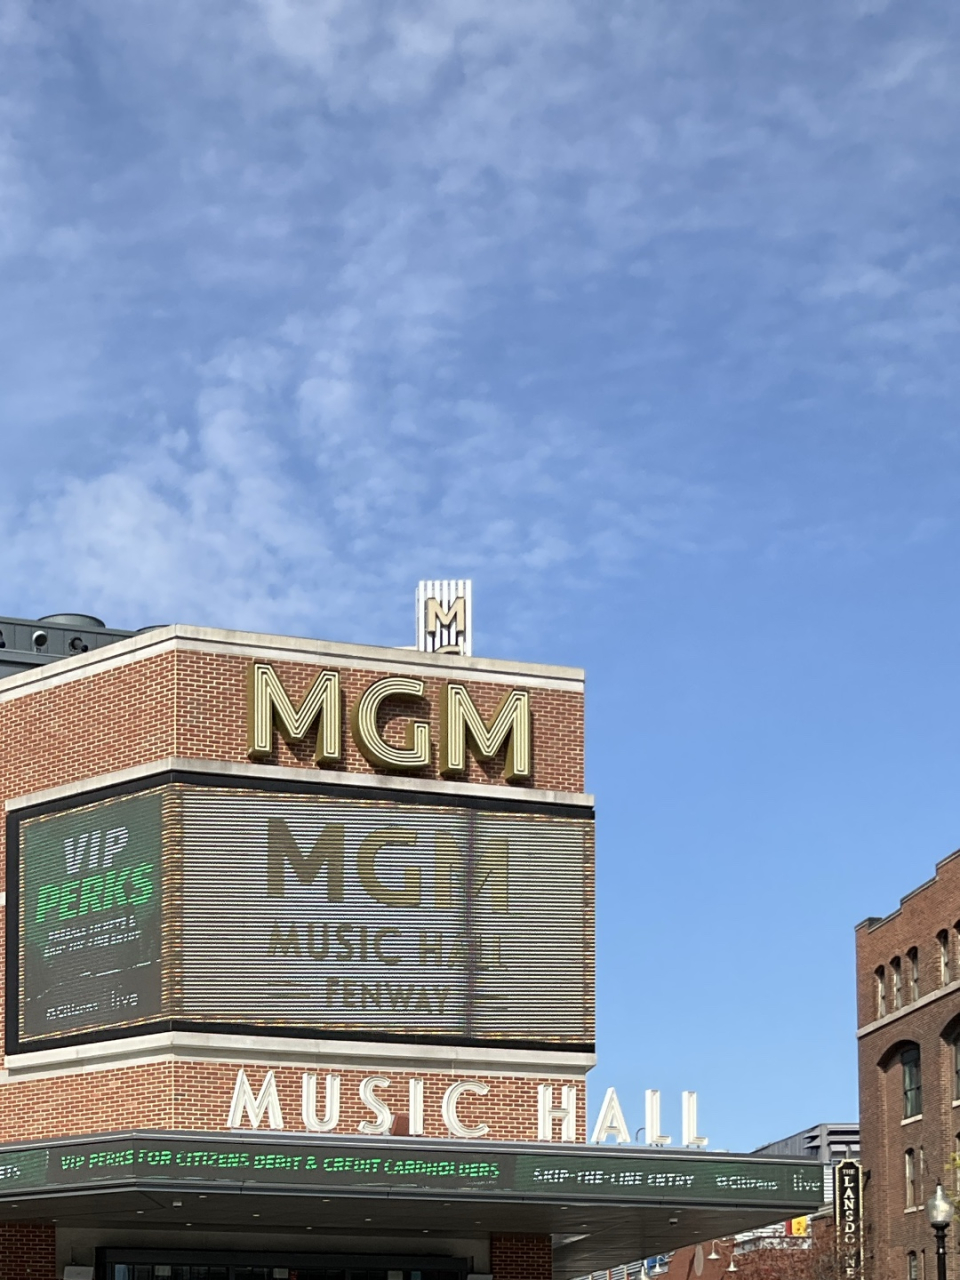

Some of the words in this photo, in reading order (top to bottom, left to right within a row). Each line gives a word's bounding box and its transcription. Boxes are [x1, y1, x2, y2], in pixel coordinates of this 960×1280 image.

[428, 596, 465, 655] M
[247, 663, 532, 783] MGM
[64, 826, 129, 874] VIP
[267, 818, 509, 915] MGM
[35, 863, 154, 923] PERKS
[269, 920, 403, 965] MUSIC
[419, 930, 508, 970] HALL
[326, 976, 451, 1015] FENWAY
[227, 1069, 491, 1138] MUSIC
[537, 1083, 709, 1148] HALL
[61, 1155, 86, 1170] VIP
[89, 1150, 134, 1168] PERKS
[138, 1150, 172, 1166] FOR
[176, 1151, 250, 1168] CITIZENS
[253, 1154, 302, 1170] DEBIT
[305, 1156, 318, 1170] &
[323, 1157, 382, 1173] CREDIT
[384, 1159, 500, 1178] CARDHOLDERS
[533, 1168, 644, 1185] SKIP-THE-LINE
[646, 1173, 695, 1188] ENTRY
[793, 1169, 821, 1191] live
